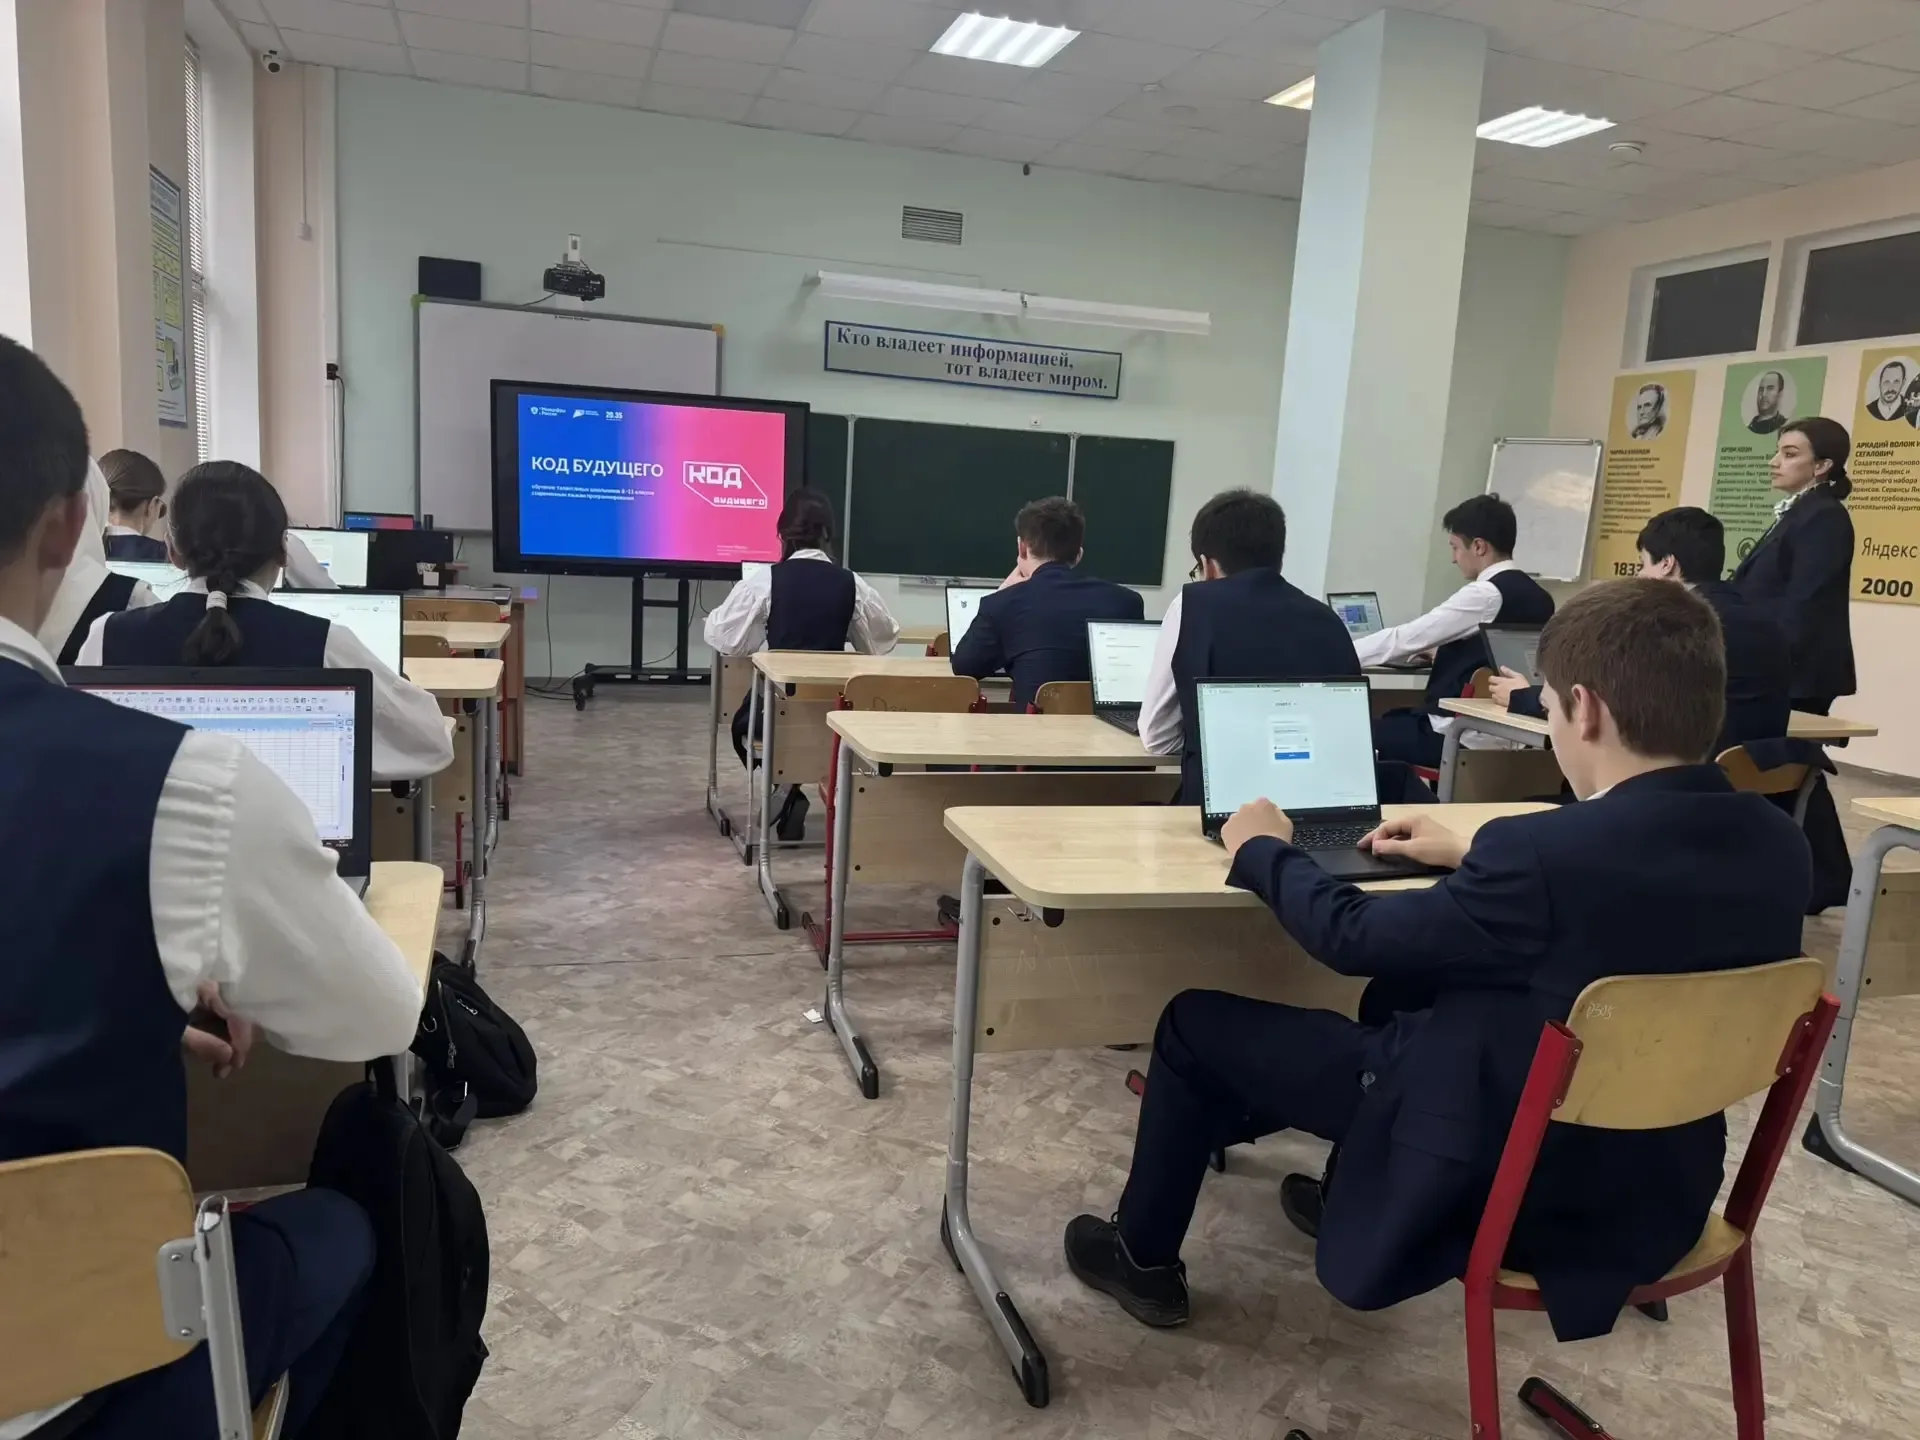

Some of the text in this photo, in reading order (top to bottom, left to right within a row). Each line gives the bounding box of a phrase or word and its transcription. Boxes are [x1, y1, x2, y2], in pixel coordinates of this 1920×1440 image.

[836, 327, 1074, 370] Кто владеет информацией,
[945, 362, 1108, 391] тот владеет миром.
[1856, 440, 1889, 449] АРКАДИЙ
[1889, 440, 1916, 448] ВОЛОЖ
[1855, 450, 1894, 458] СЕГАЛОВИЧ
[531, 456, 664, 479] КОД БУДУЩЕГО
[1854, 459, 1887, 467] Создатели
[688, 465, 742, 489] КОД
[1880, 468, 1905, 476] Яндекс
[713, 496, 765, 506] БУДУЩЕГО
[1870, 495, 1920, 503] востребованны
[1897, 505, 1920, 513] аудито
[1861, 537, 1918, 560] Яндекс
[1861, 578, 1913, 598] 2000
